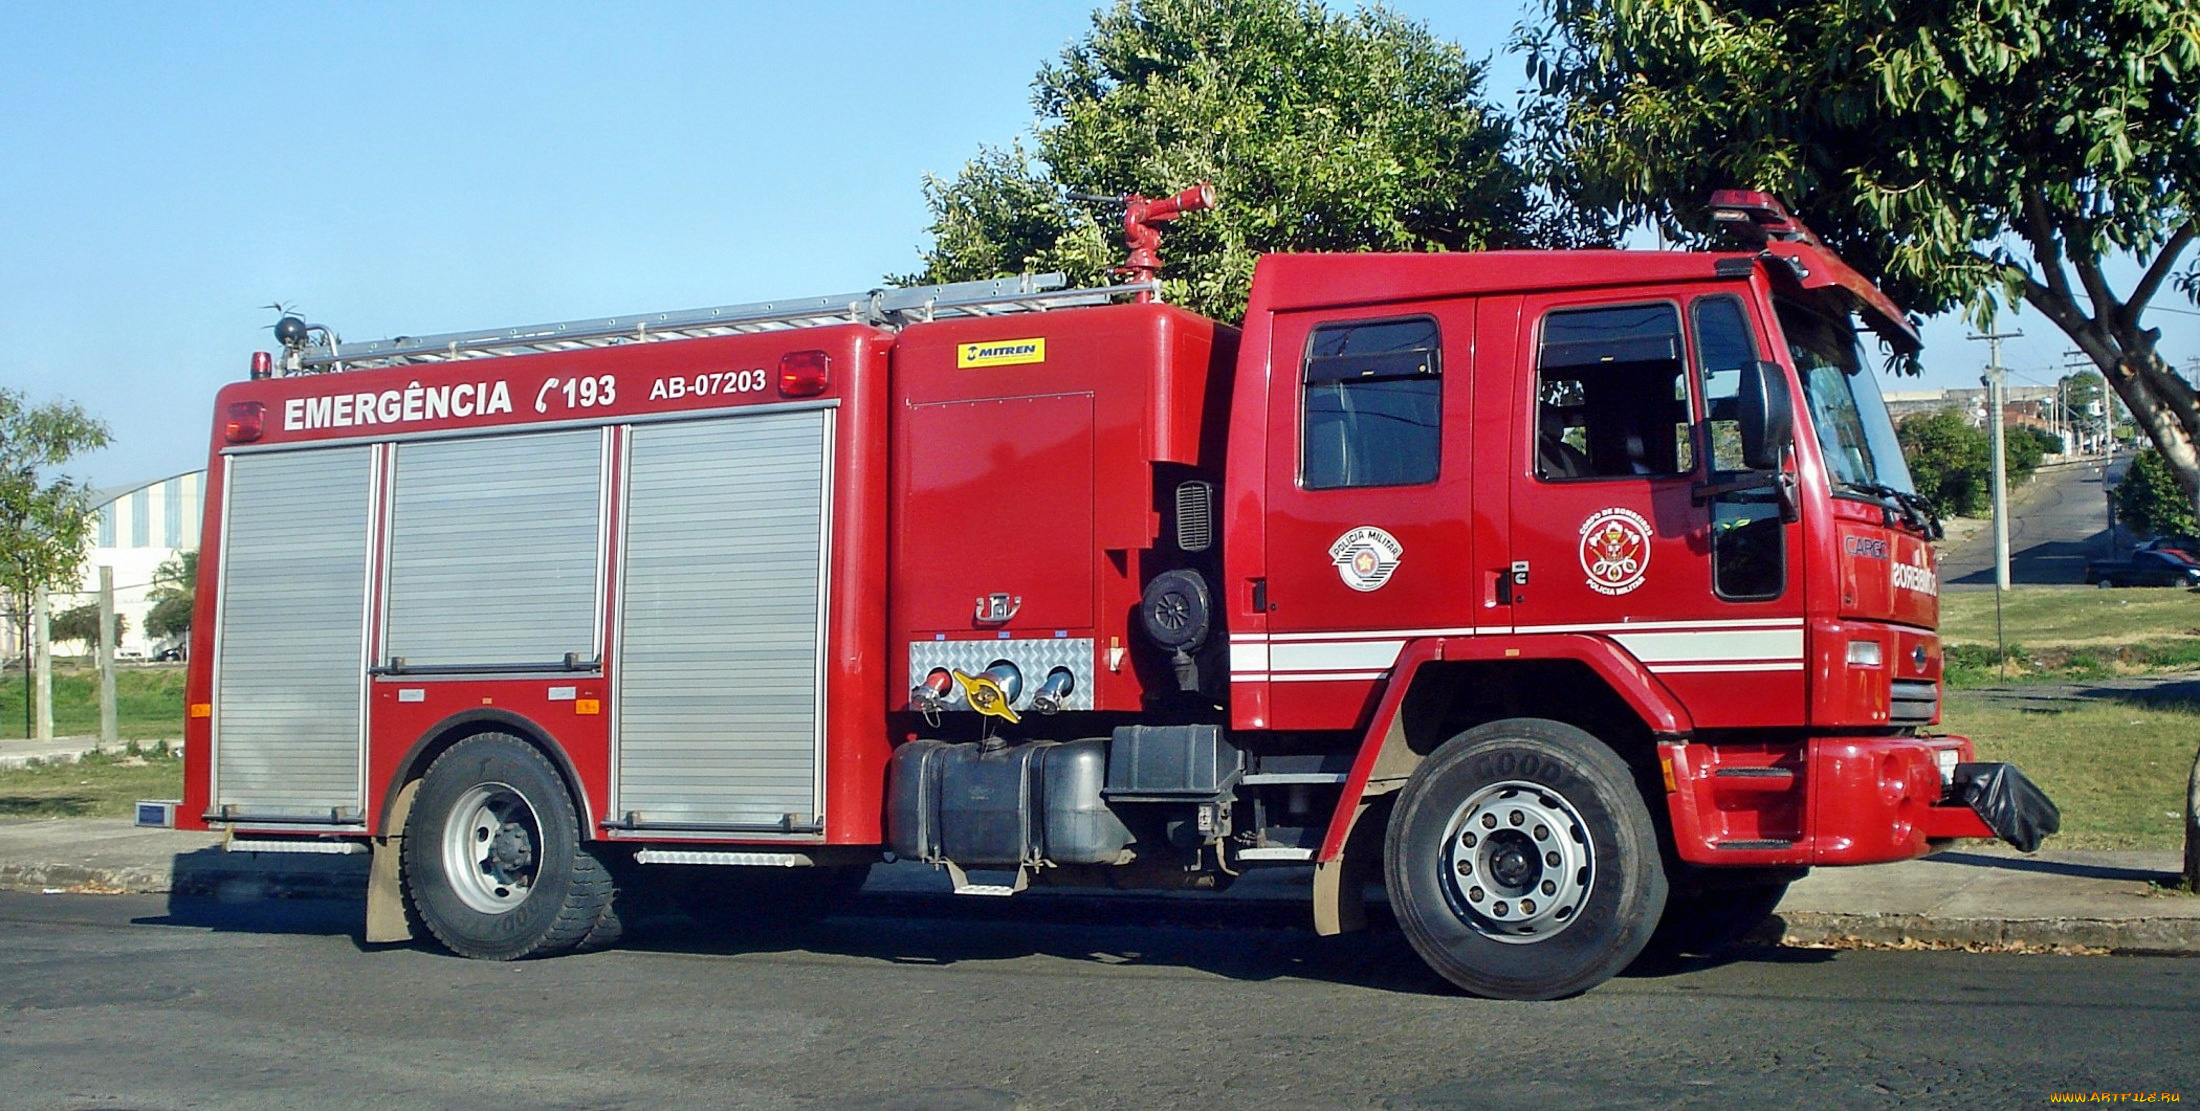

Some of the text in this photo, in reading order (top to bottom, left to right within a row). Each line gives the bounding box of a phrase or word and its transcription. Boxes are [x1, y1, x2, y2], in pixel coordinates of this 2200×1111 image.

[979, 345, 1035, 356] MITREN
[283, 369, 767, 431] EMERGÊNCIA 193 AB-07203
[1601, 508, 1613, 517] DE
[1368, 530, 1398, 555] MILITAR
